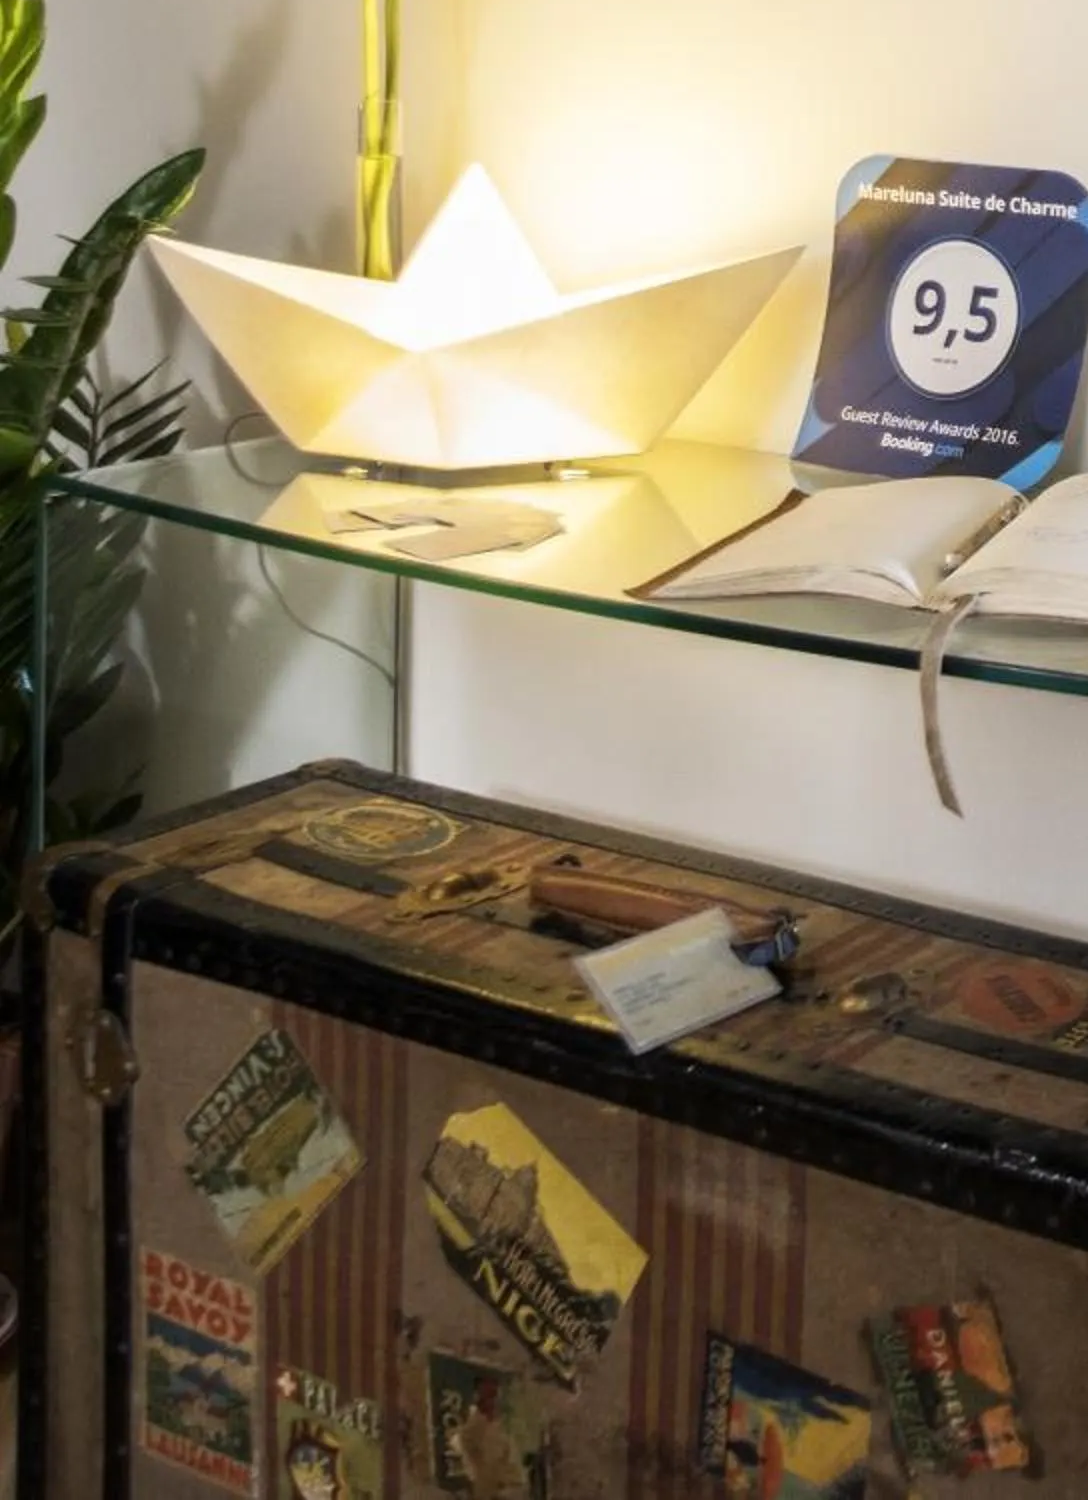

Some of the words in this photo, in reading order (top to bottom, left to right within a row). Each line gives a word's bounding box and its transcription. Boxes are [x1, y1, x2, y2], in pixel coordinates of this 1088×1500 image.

[857, 182, 935, 206] Mareluna
[939, 189, 981, 210] Suite
[984, 194, 1005, 212] de
[1009, 197, 1078, 219] Charme
[913, 280, 999, 348] 9,5
[841, 405, 880, 425] Guest
[881, 411, 929, 432] Review
[929, 419, 980, 440] Awards
[145, 1252, 252, 1317] ROYAL
[148, 1282, 252, 1344] SAVOY
[474, 1257, 577, 1381] NICE
